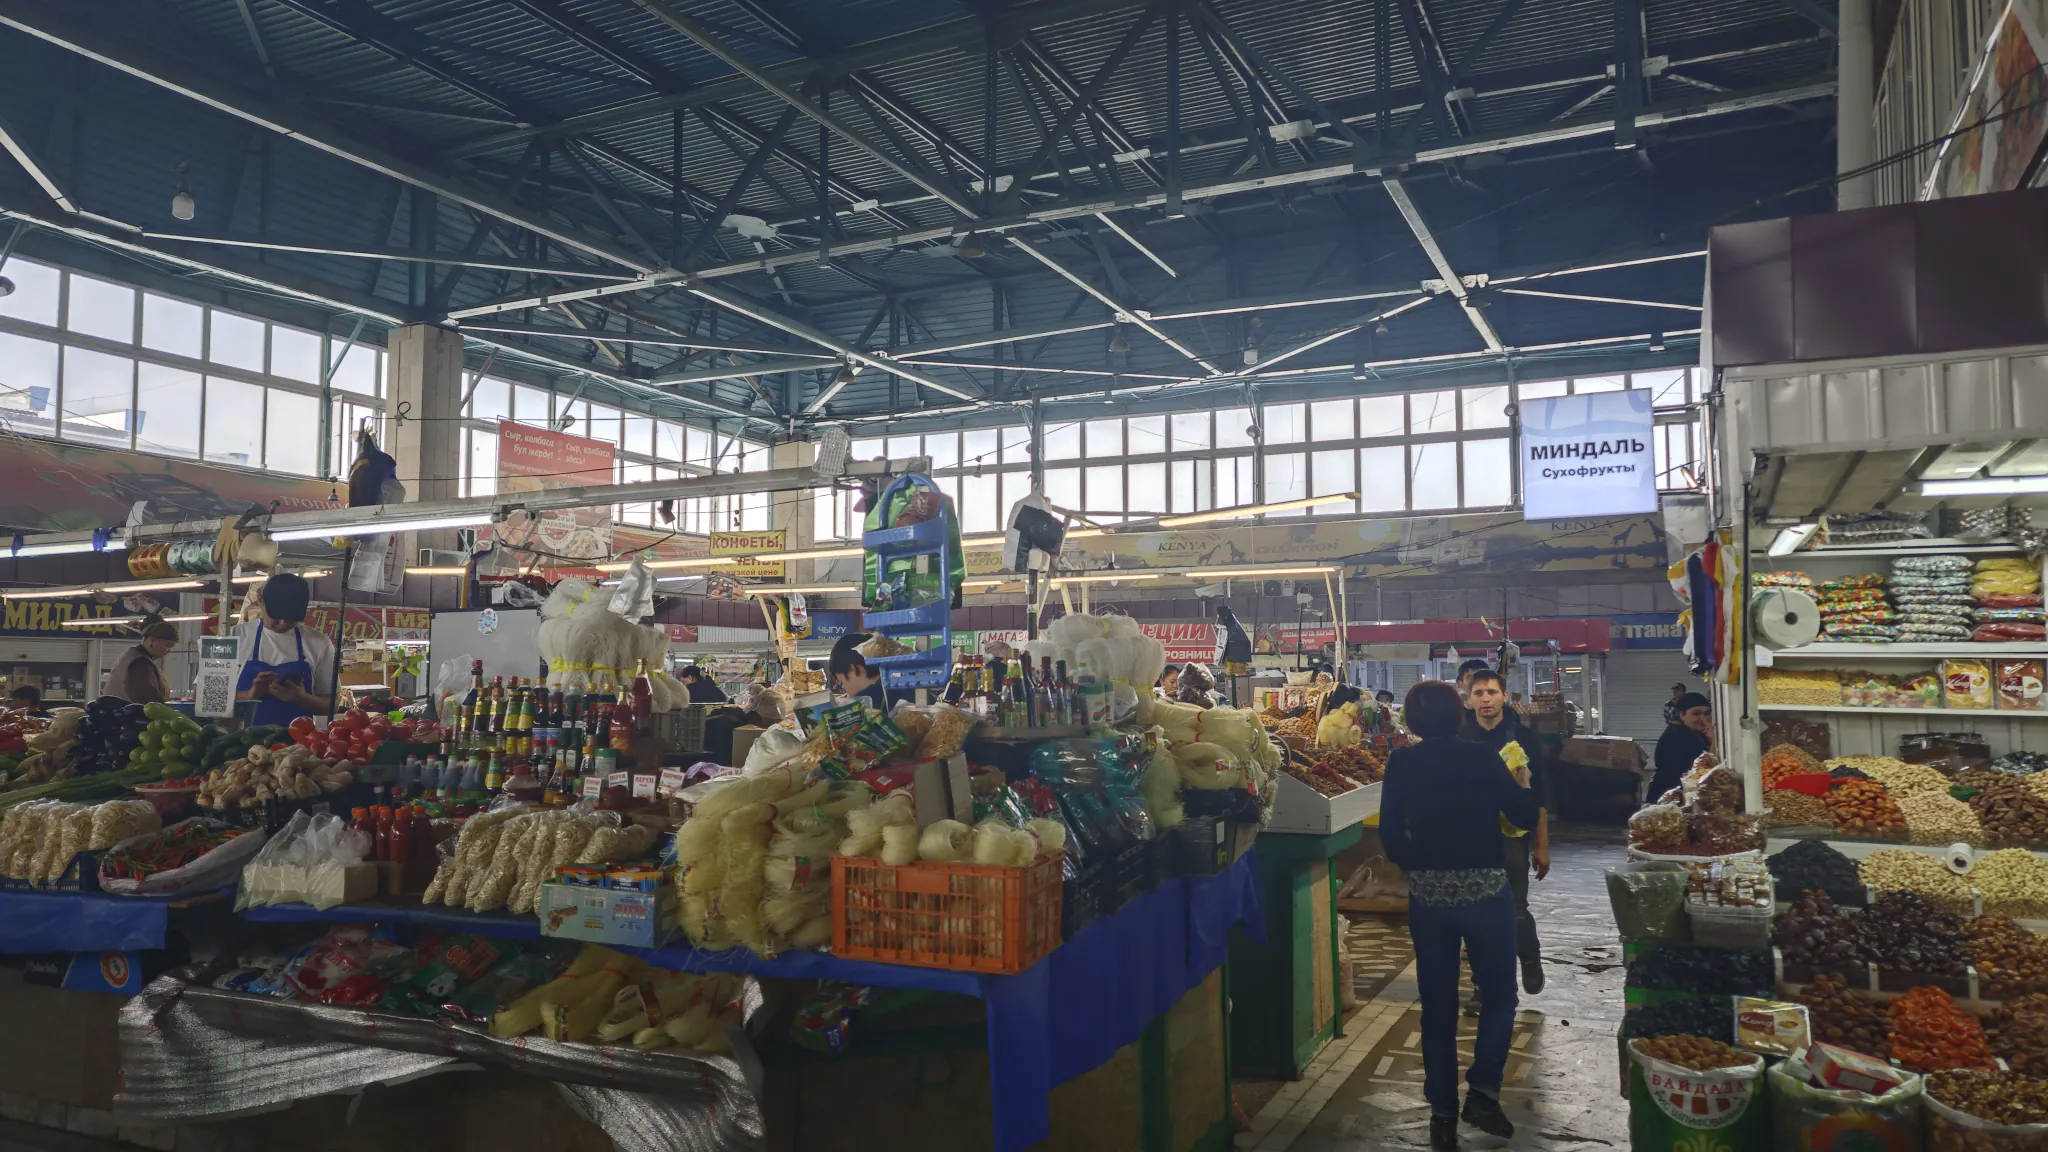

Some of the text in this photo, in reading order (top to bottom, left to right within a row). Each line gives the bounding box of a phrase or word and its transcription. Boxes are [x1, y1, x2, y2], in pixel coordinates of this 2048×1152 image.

[505, 430, 555, 447] Сыр, колбаса
[565, 443, 611, 458] Сыр, колбаса
[1531, 438, 1645, 460] МИНДАЛЬ
[1542, 464, 1635, 479] Сухофрукты
[712, 536, 783, 550] КОНФЕТЫ,
[1158, 541, 1206, 551] KENYA
[817, 626, 846, 634] ЧЫГУУ
[1139, 623, 1208, 645] ЕЦИИ
[1740, 1015, 1773, 1028] Kong
